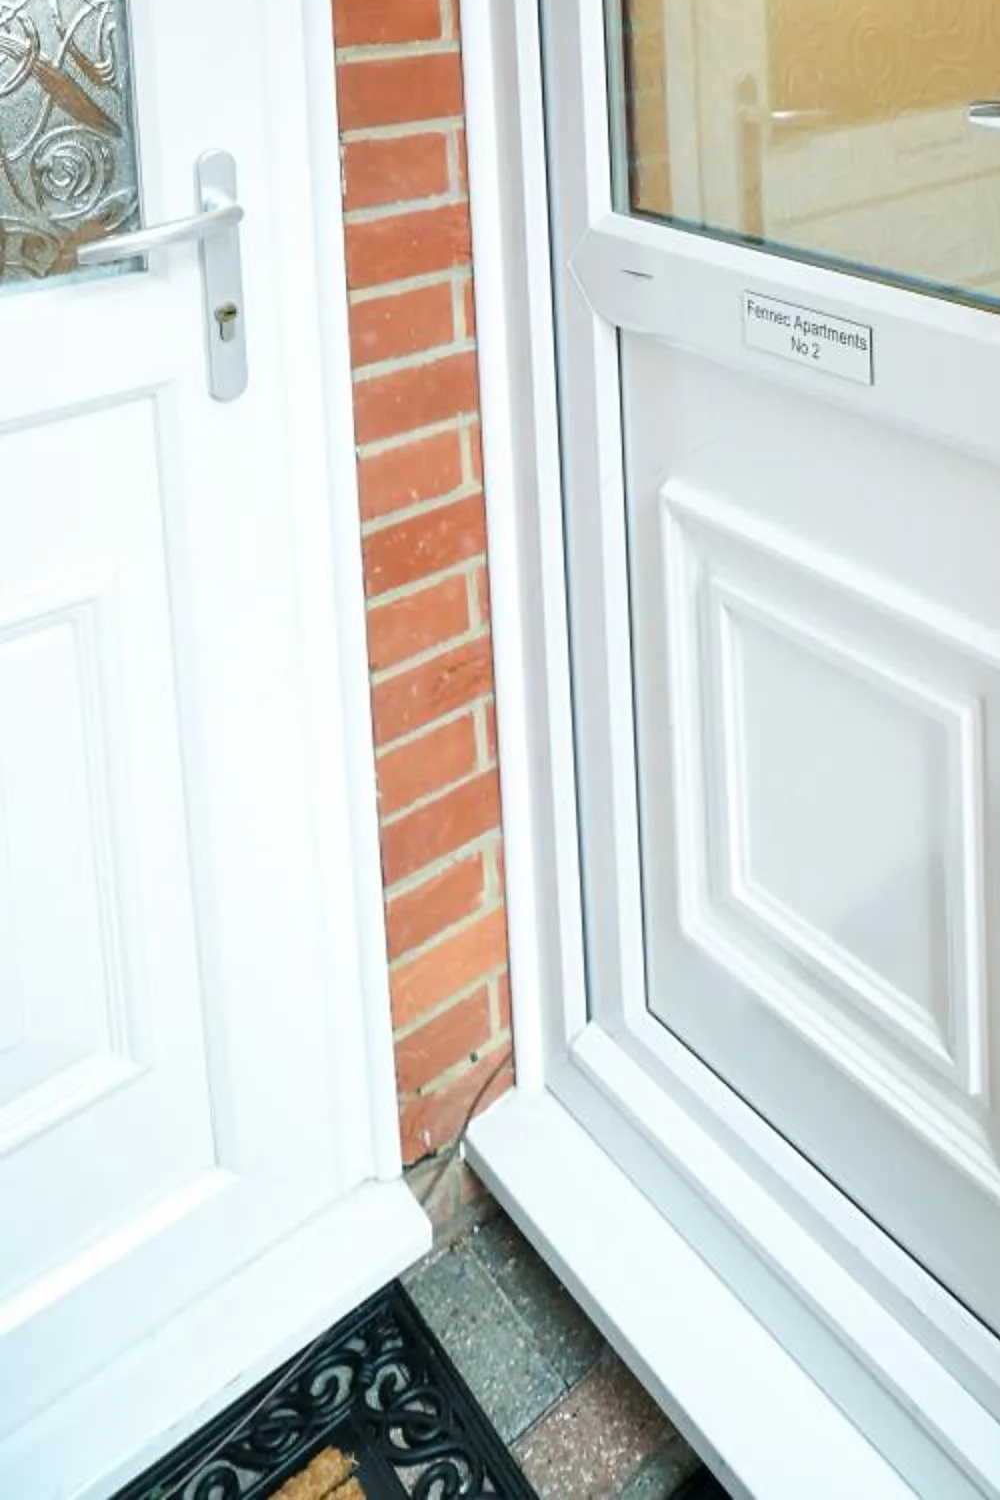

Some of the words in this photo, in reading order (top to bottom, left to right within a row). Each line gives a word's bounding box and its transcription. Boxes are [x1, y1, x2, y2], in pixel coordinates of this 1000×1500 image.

[746, 299, 791, 327] Fennec
[793, 315, 868, 351] Apartments
[791, 336, 809, 356] No
[811, 343, 821, 360] 2
